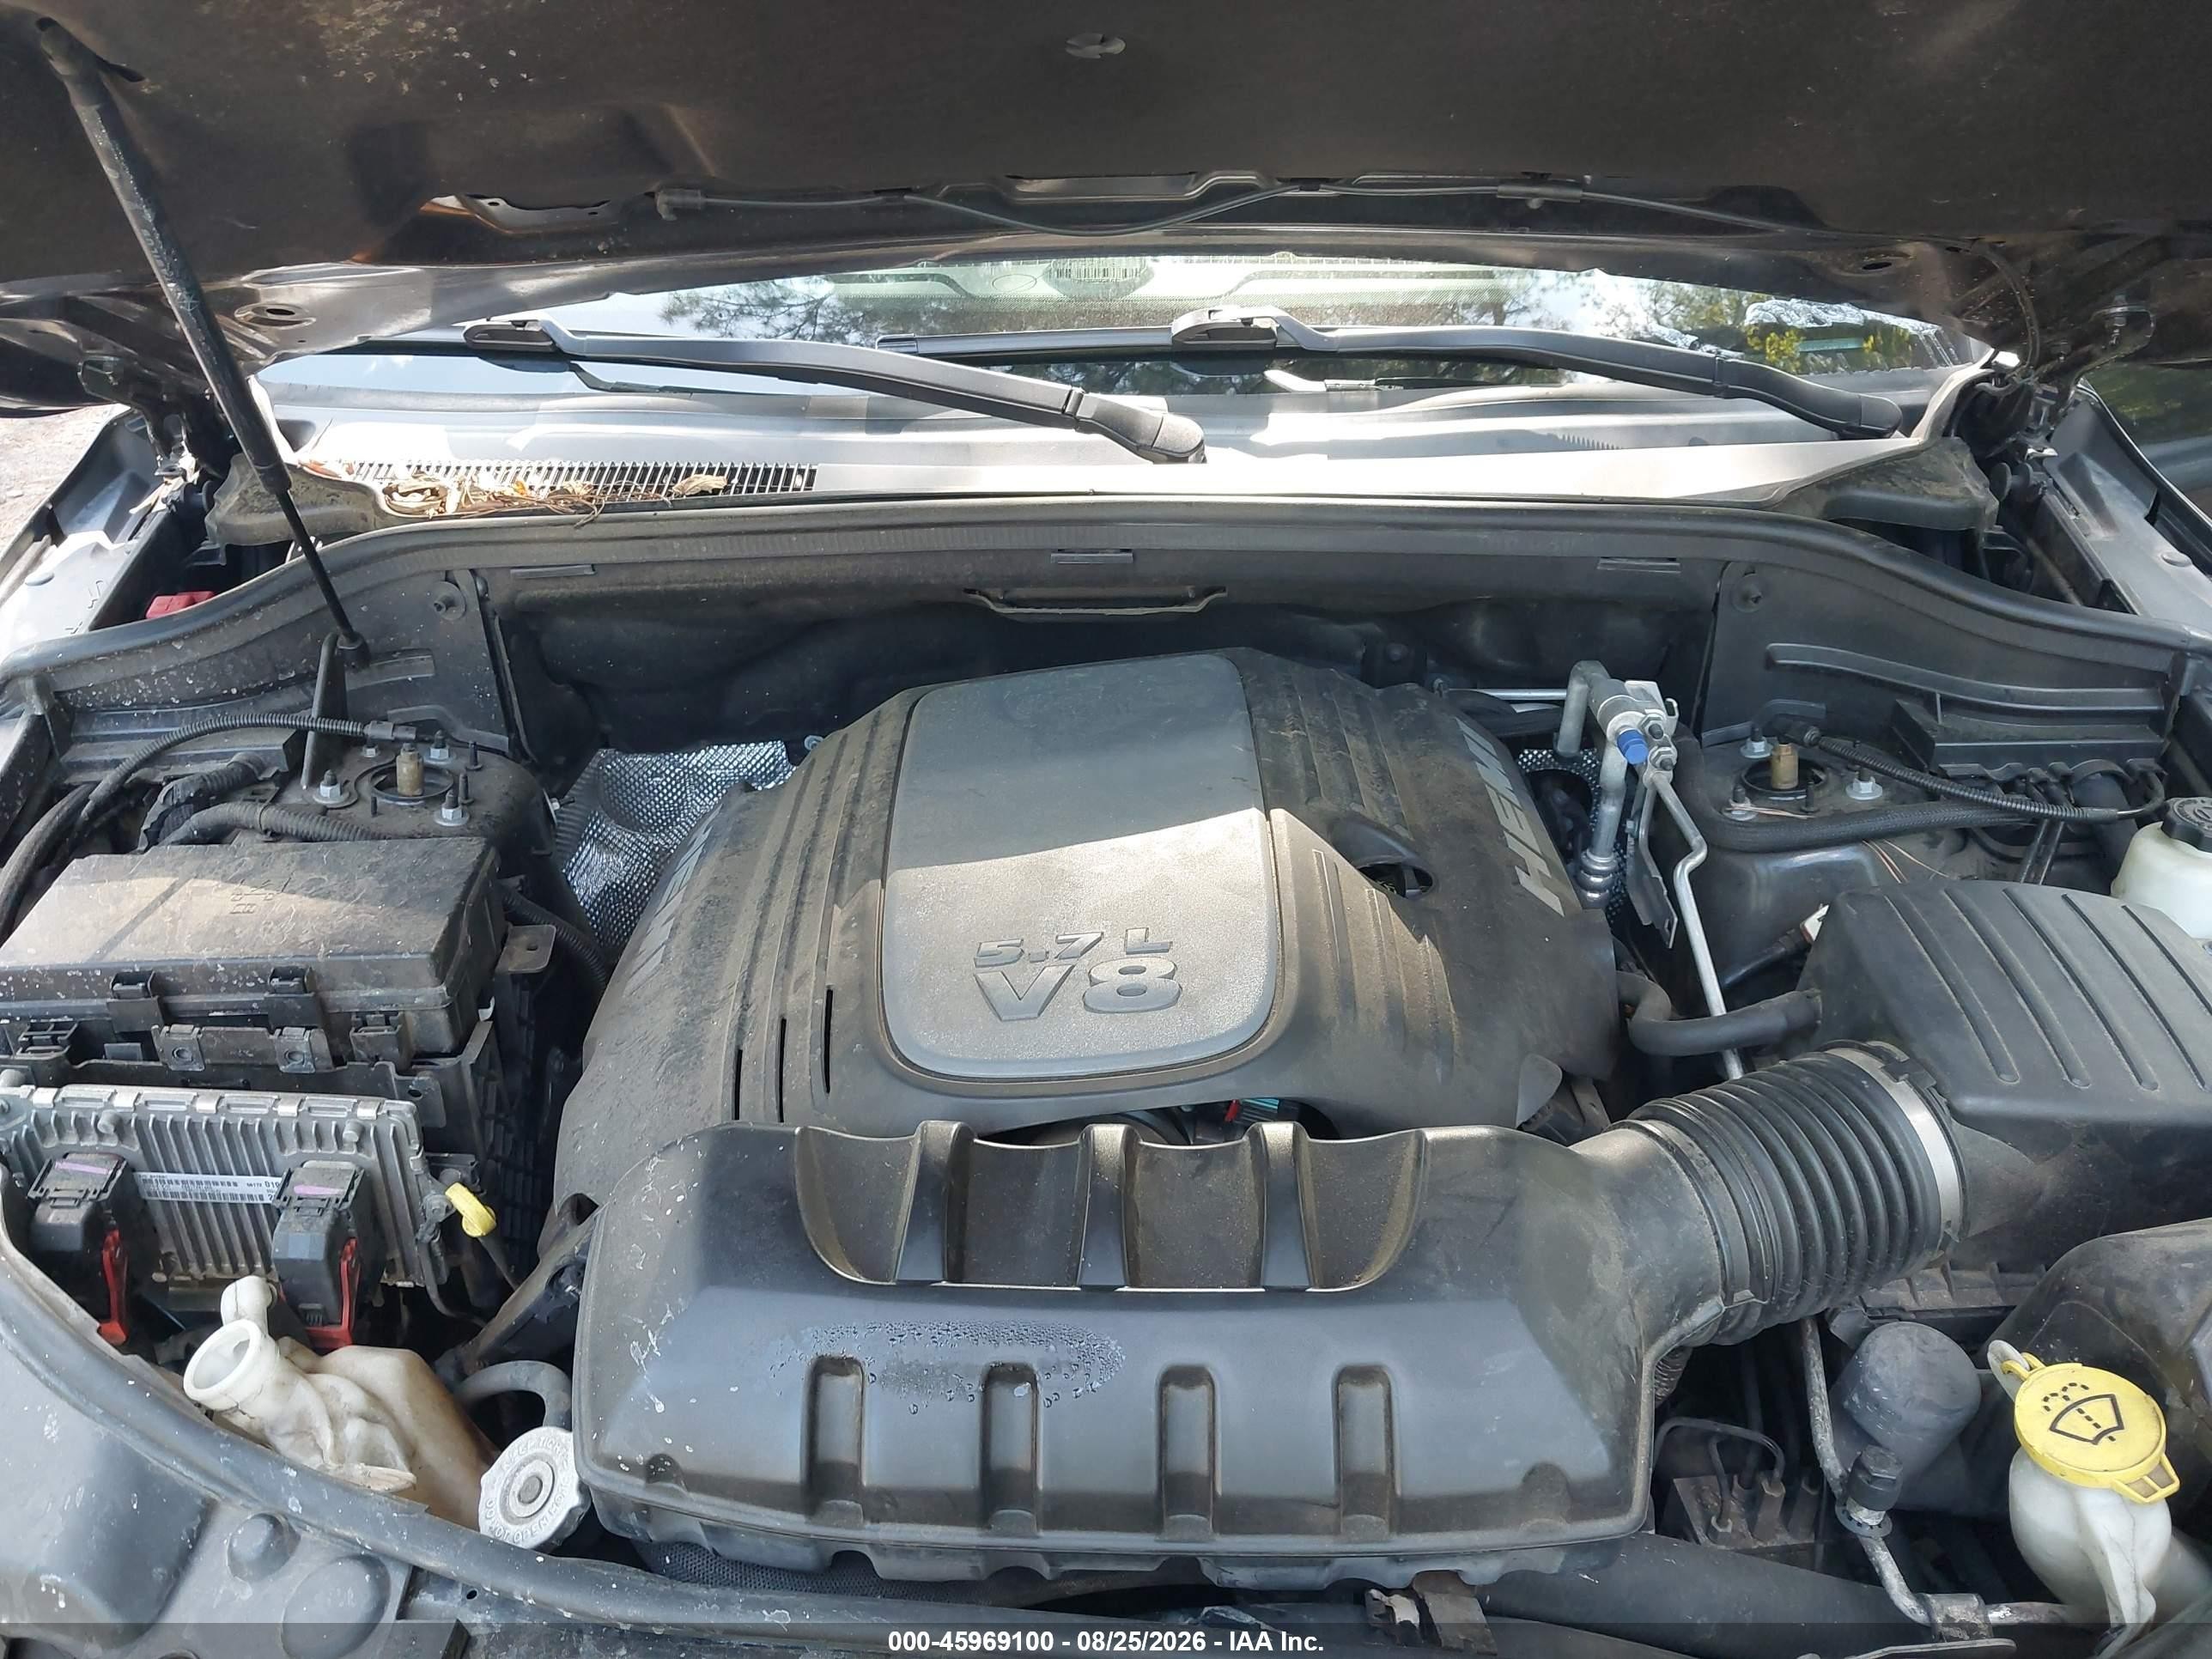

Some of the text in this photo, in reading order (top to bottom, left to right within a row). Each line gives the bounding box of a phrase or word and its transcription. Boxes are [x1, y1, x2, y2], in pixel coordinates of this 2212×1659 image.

[1455, 716, 1565, 917] HEMI
[973, 957, 1183, 1023] V8
[514, 1516, 551, 1544] OPEN
